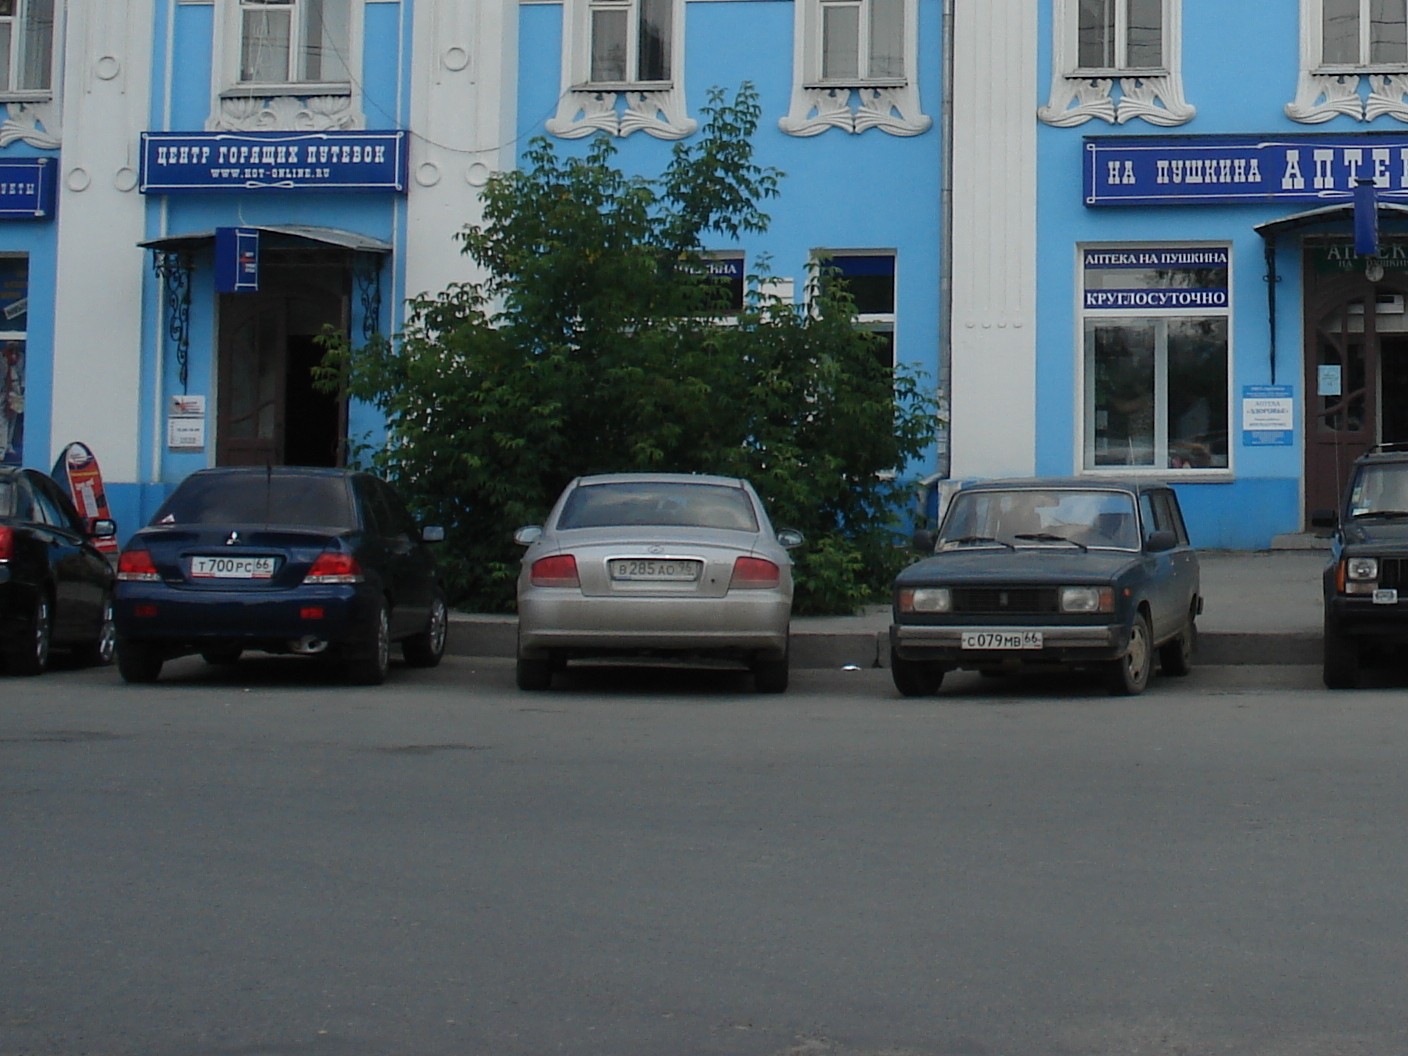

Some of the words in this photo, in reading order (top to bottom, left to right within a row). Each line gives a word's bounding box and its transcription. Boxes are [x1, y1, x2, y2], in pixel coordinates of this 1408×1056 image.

[157, 147, 210, 166] ЦЕНТР
[218, 146, 298, 165] ГОРЯЩИХ
[307, 146, 385, 164] ПУТЕВОК
[1108, 161, 1136, 184] НА
[1157, 159, 1262, 183] ПУШКИНА
[1085, 254, 1137, 264] АПТЕКА
[1140, 254, 1158, 264] НА
[1161, 253, 1227, 263] ПУШКИНА
[1086, 293, 1226, 305] КРУГЛОСУТОЧНО
